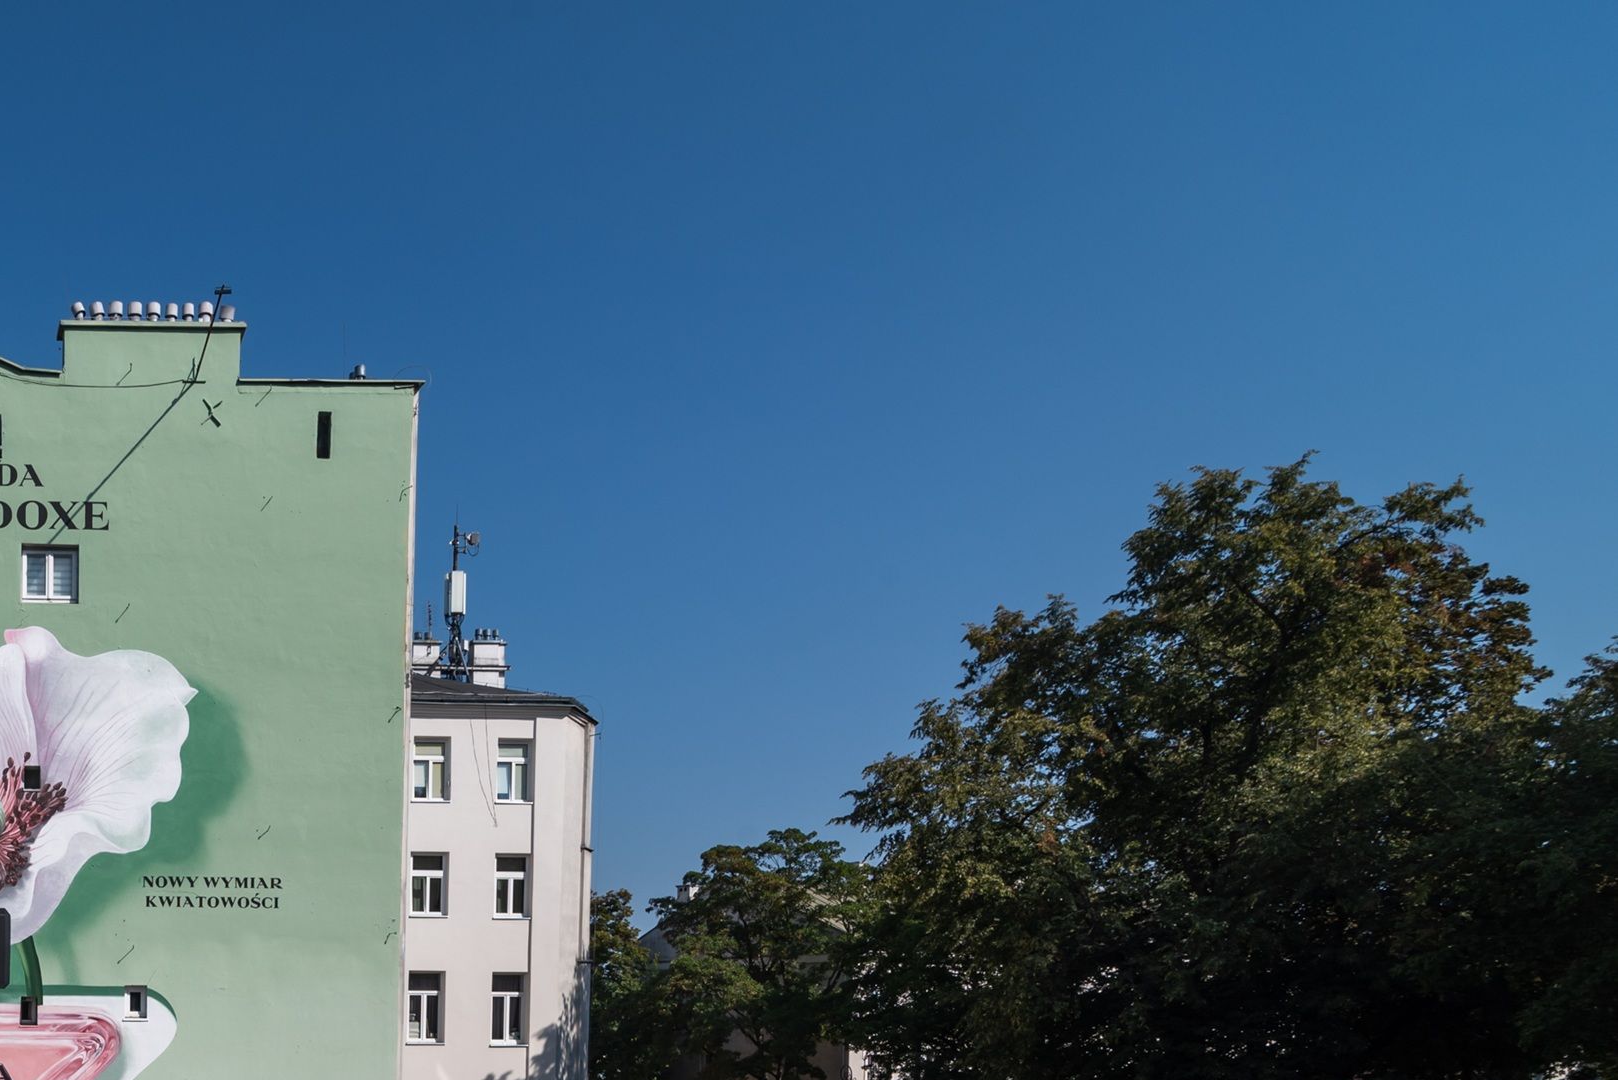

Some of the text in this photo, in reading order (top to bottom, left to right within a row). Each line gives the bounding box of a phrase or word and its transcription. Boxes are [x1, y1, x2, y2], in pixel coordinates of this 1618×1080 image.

[142, 875, 283, 889] NOWY WYMIAR
[145, 893, 279, 909] KWIATOWOŚCI
